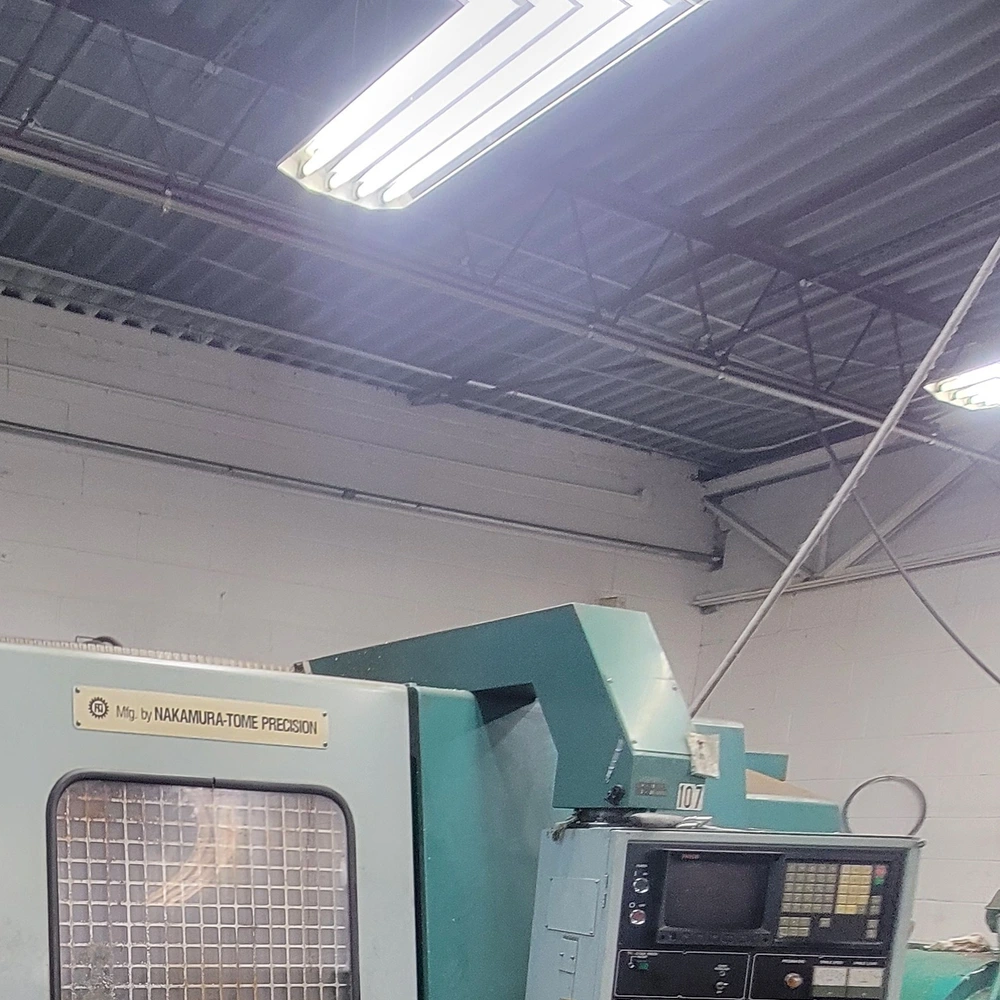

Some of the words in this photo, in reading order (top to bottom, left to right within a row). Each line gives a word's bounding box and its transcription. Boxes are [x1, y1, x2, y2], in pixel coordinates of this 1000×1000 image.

[116, 705, 138, 722] Mfg.
[141, 706, 153, 723] by
[154, 706, 258, 729] NAKAMURA-TOME
[262, 718, 318, 735] PRECISION
[678, 785, 703, 809] 107
